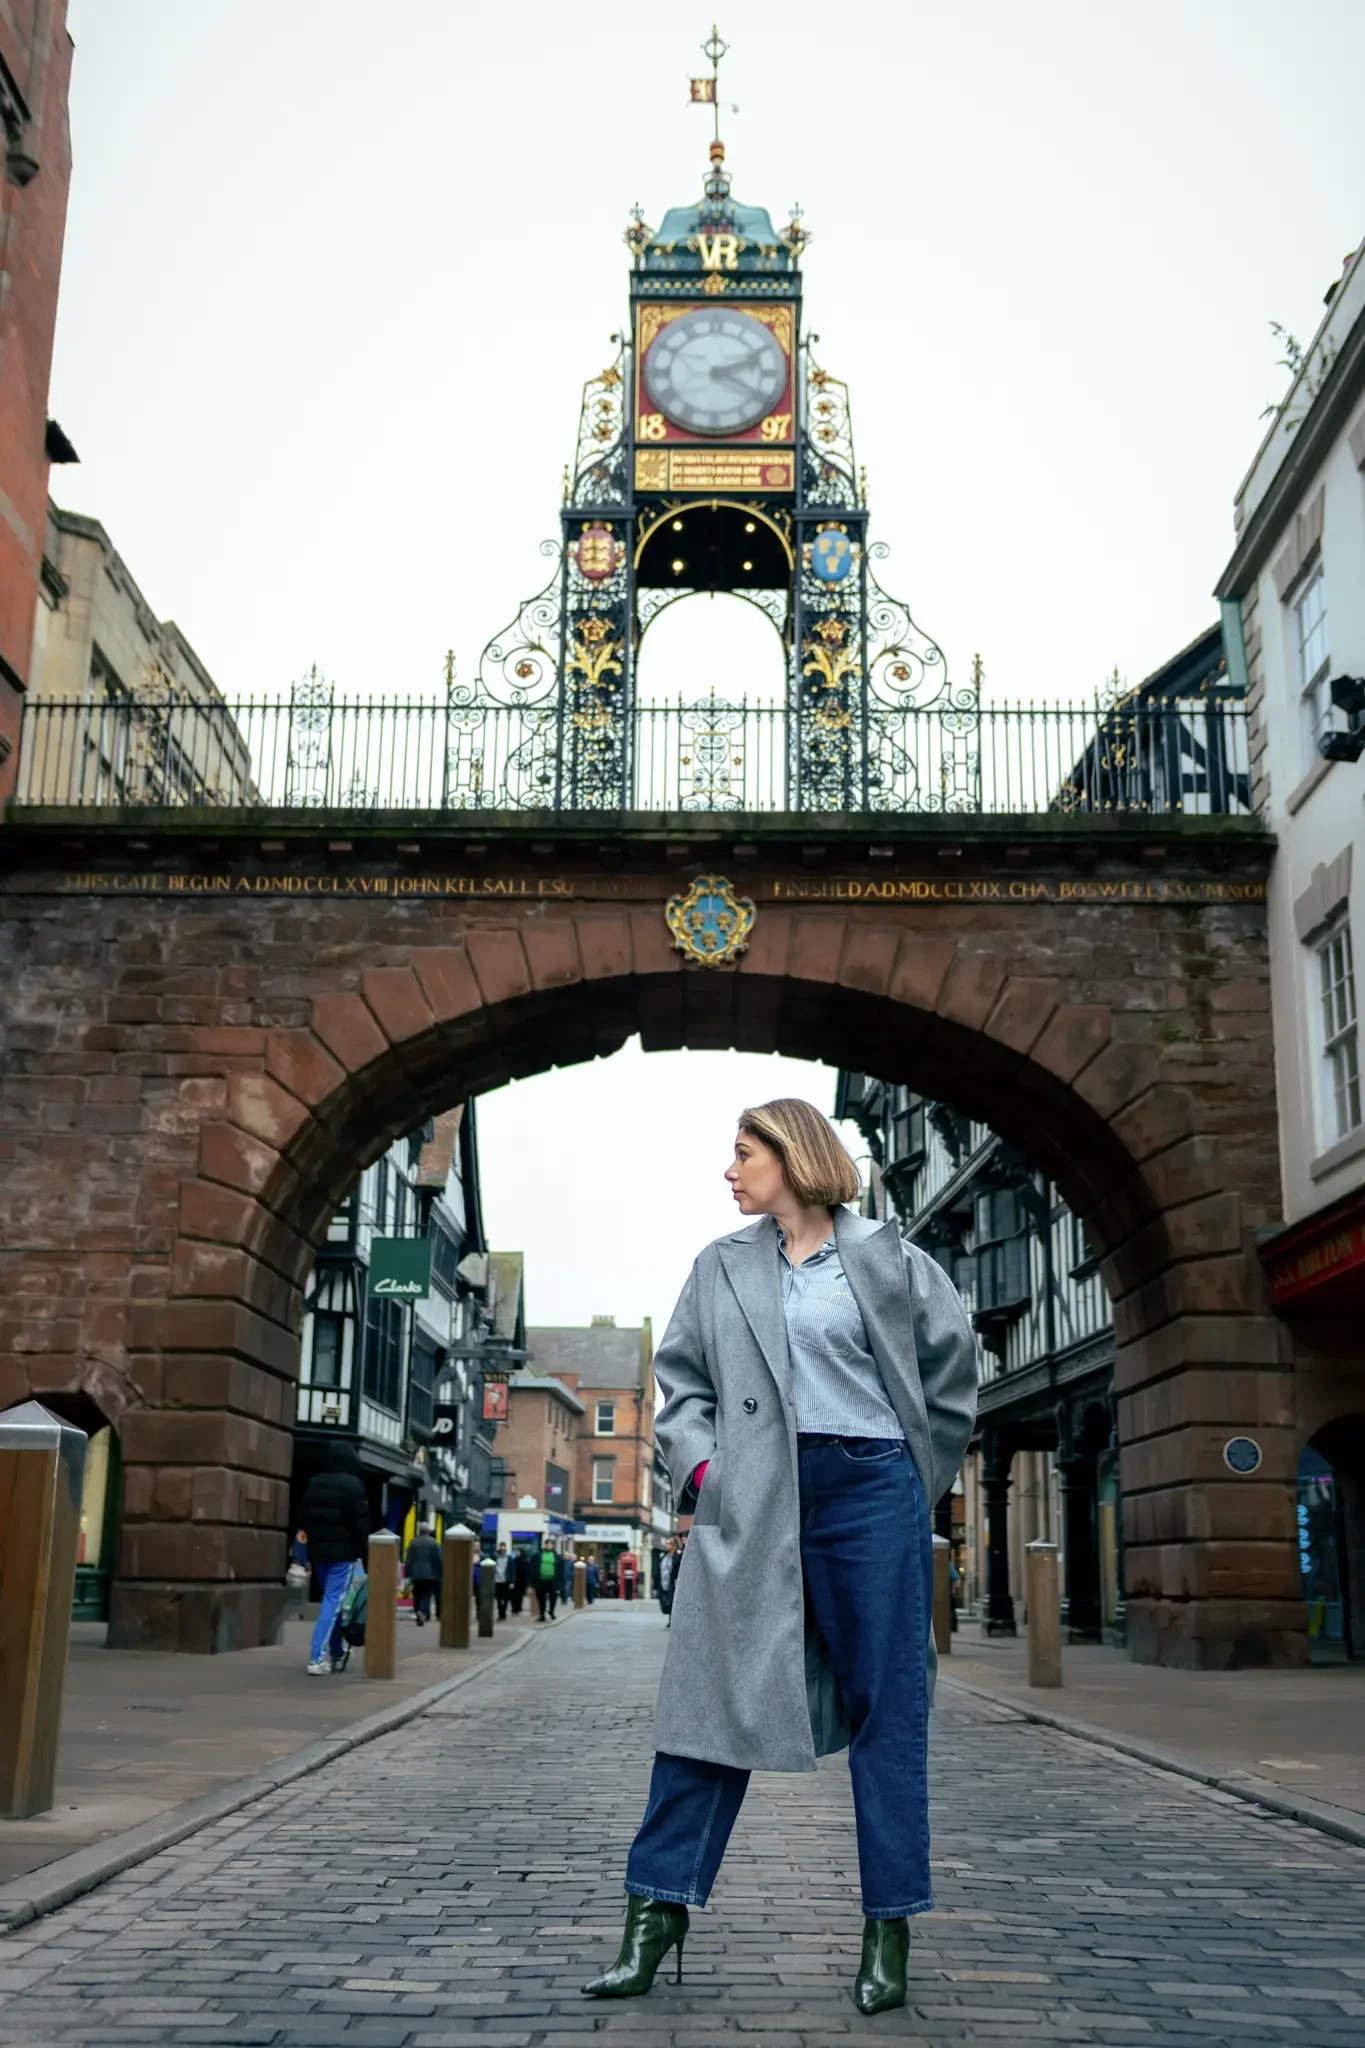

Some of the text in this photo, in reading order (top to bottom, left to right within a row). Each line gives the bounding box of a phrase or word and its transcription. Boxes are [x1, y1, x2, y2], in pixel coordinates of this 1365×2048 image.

[639, 413, 792, 442] 18 97
[168, 875, 231, 891] BEGUN
[393, 878, 440, 897] JOHN
[445, 878, 533, 895] KELSALL
[374, 1278, 422, 1293] Clarks
[431, 1417, 453, 1434] JD
